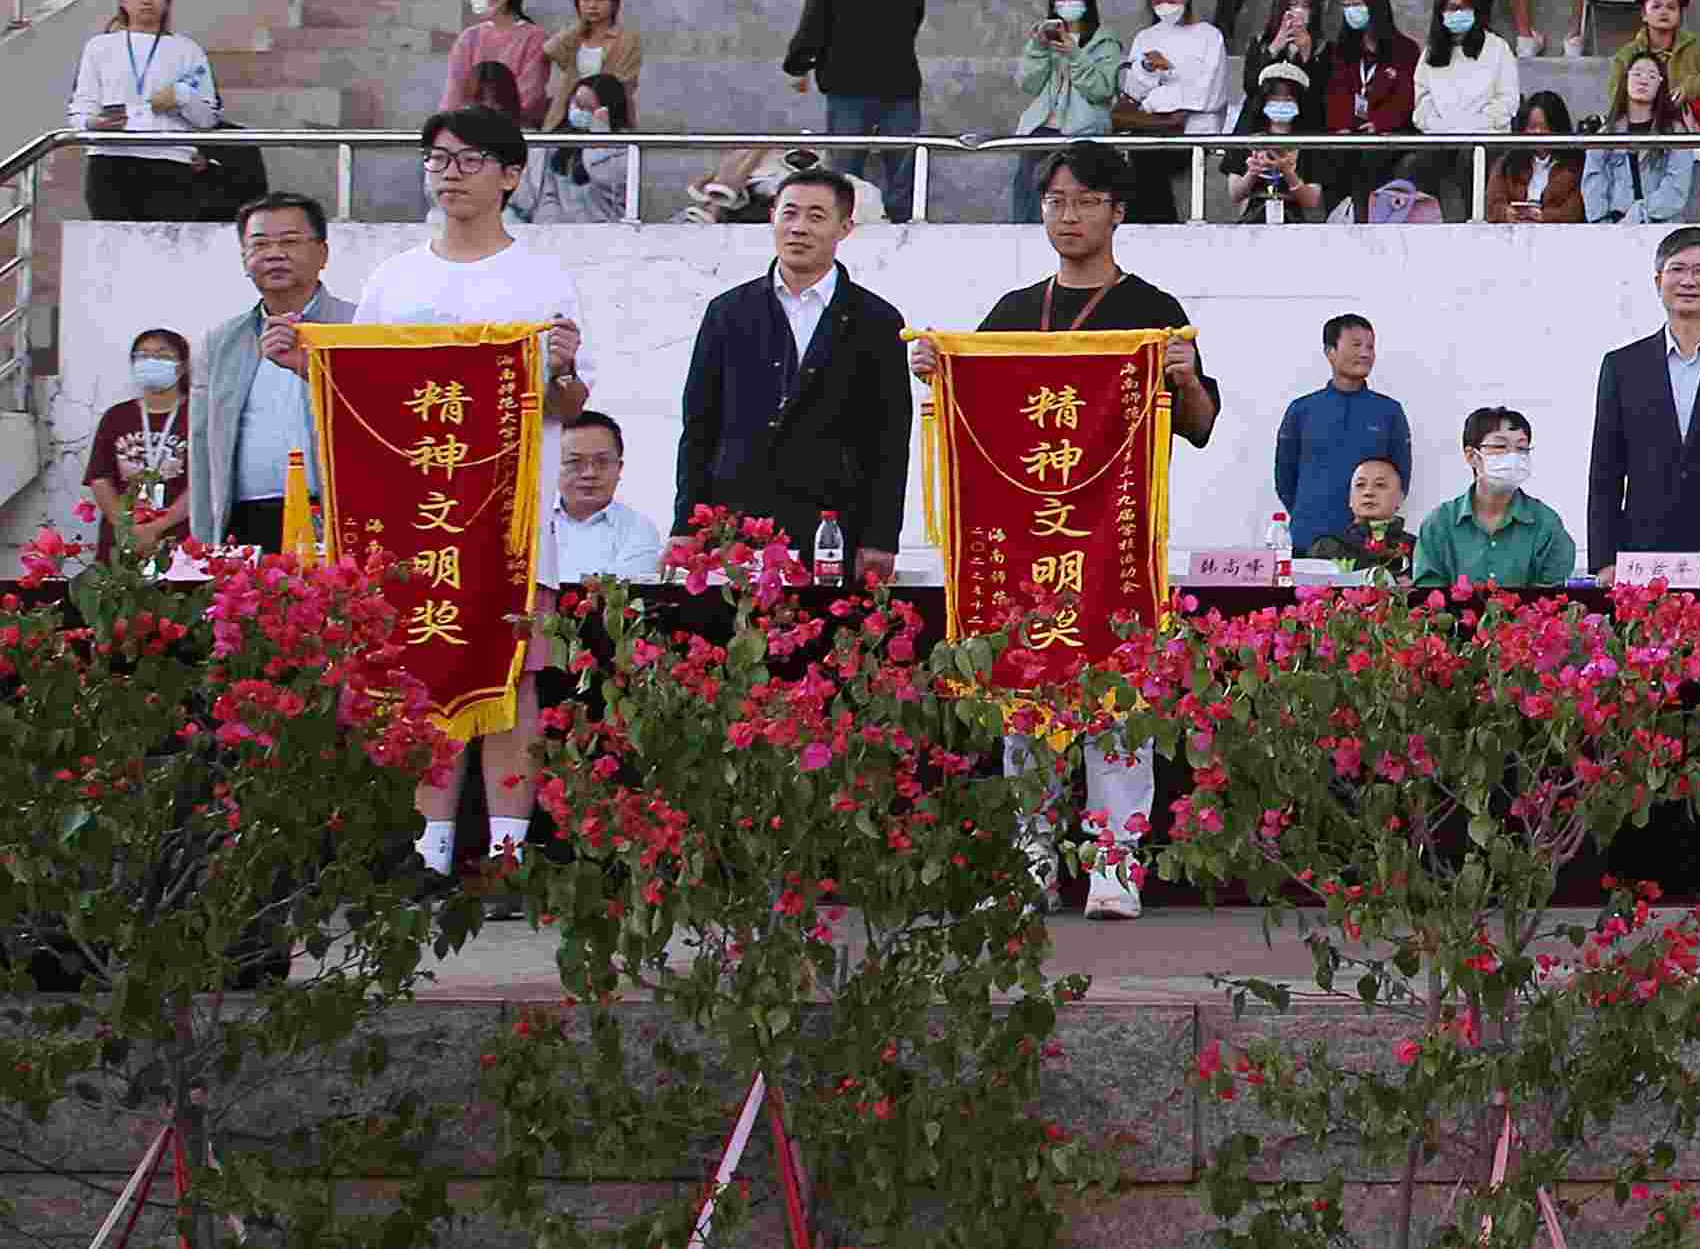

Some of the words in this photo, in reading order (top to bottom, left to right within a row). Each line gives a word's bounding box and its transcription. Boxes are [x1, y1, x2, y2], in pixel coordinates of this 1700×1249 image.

[402, 380, 473, 646] 精神文明奖
[1019, 385, 1093, 651] 精神文明奖
